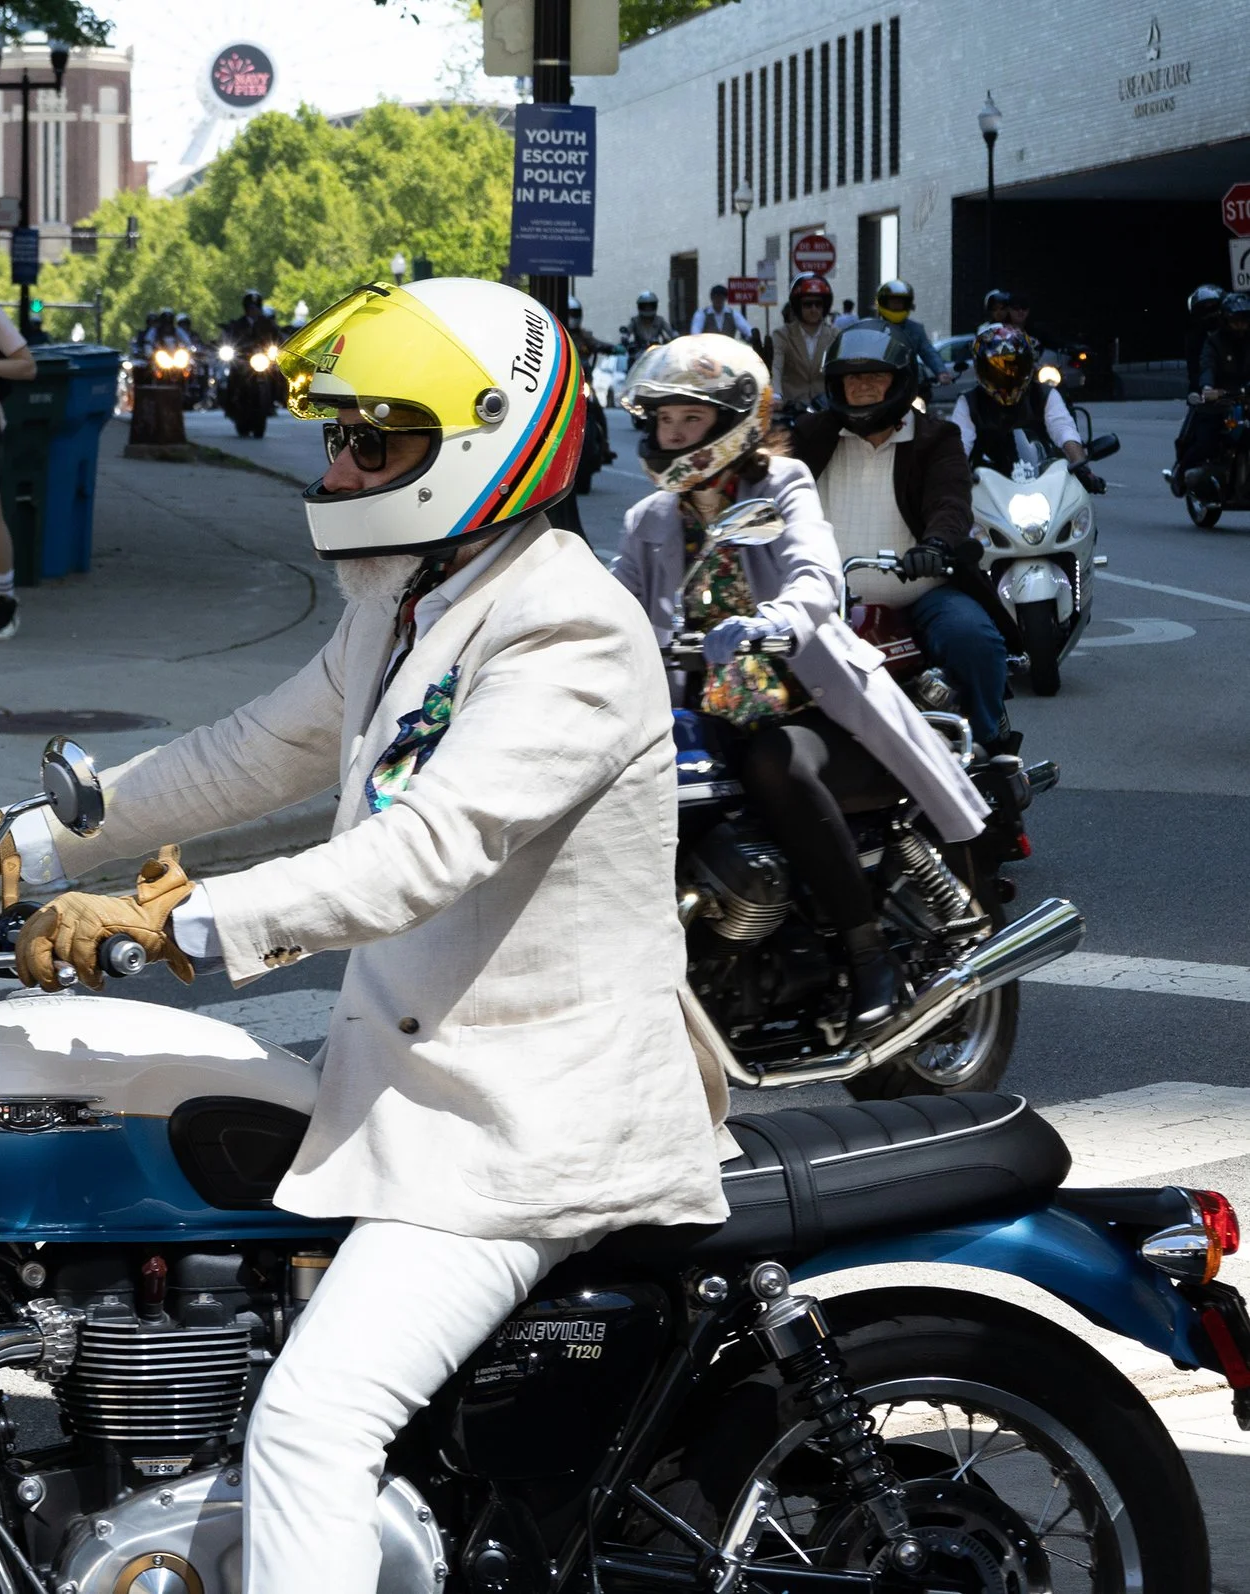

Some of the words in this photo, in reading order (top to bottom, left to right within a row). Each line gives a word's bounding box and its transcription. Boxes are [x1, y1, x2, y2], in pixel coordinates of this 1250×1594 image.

[234, 73, 270, 85] NAVY
[234, 85, 268, 96] PIER
[524, 128, 587, 146] YOUTH
[522, 149, 589, 166] ESCORT
[523, 168, 587, 185] POLICY
[516, 188, 535, 203] IN
[538, 189, 592, 205] PLACE
[734, 292, 754, 300] WAY
[511, 308, 549, 393] Jimmy
[492, 1321, 607, 1342] NNEVILLE
[566, 1344, 602, 1359] T120
[148, 1465, 174, 1473] 1200
